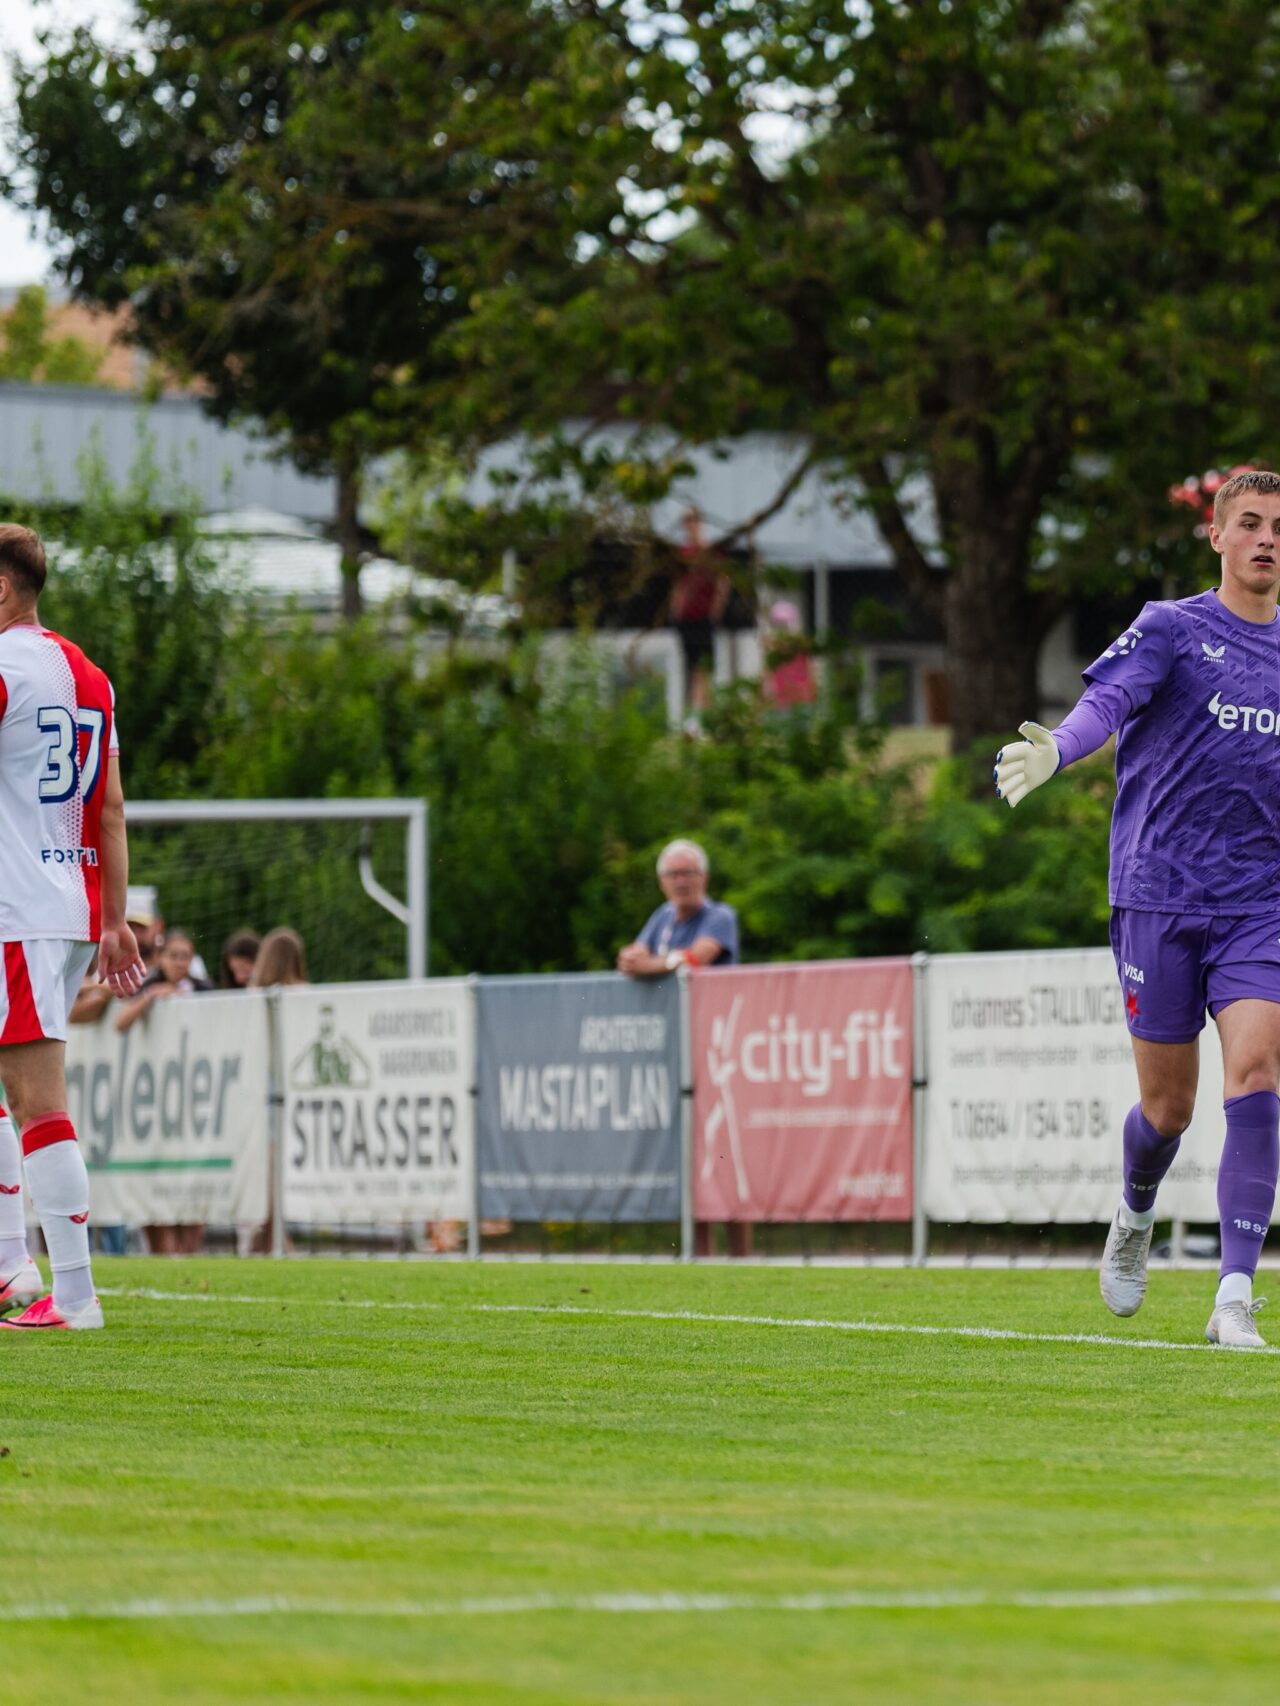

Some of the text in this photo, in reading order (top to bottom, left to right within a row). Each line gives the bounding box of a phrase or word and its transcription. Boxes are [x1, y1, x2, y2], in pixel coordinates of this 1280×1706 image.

[37, 706, 105, 804] 37
[1123, 962, 1145, 984] VISA
[740, 1010, 905, 1097] city-fit
[292, 1095, 459, 1171] STRASSER
